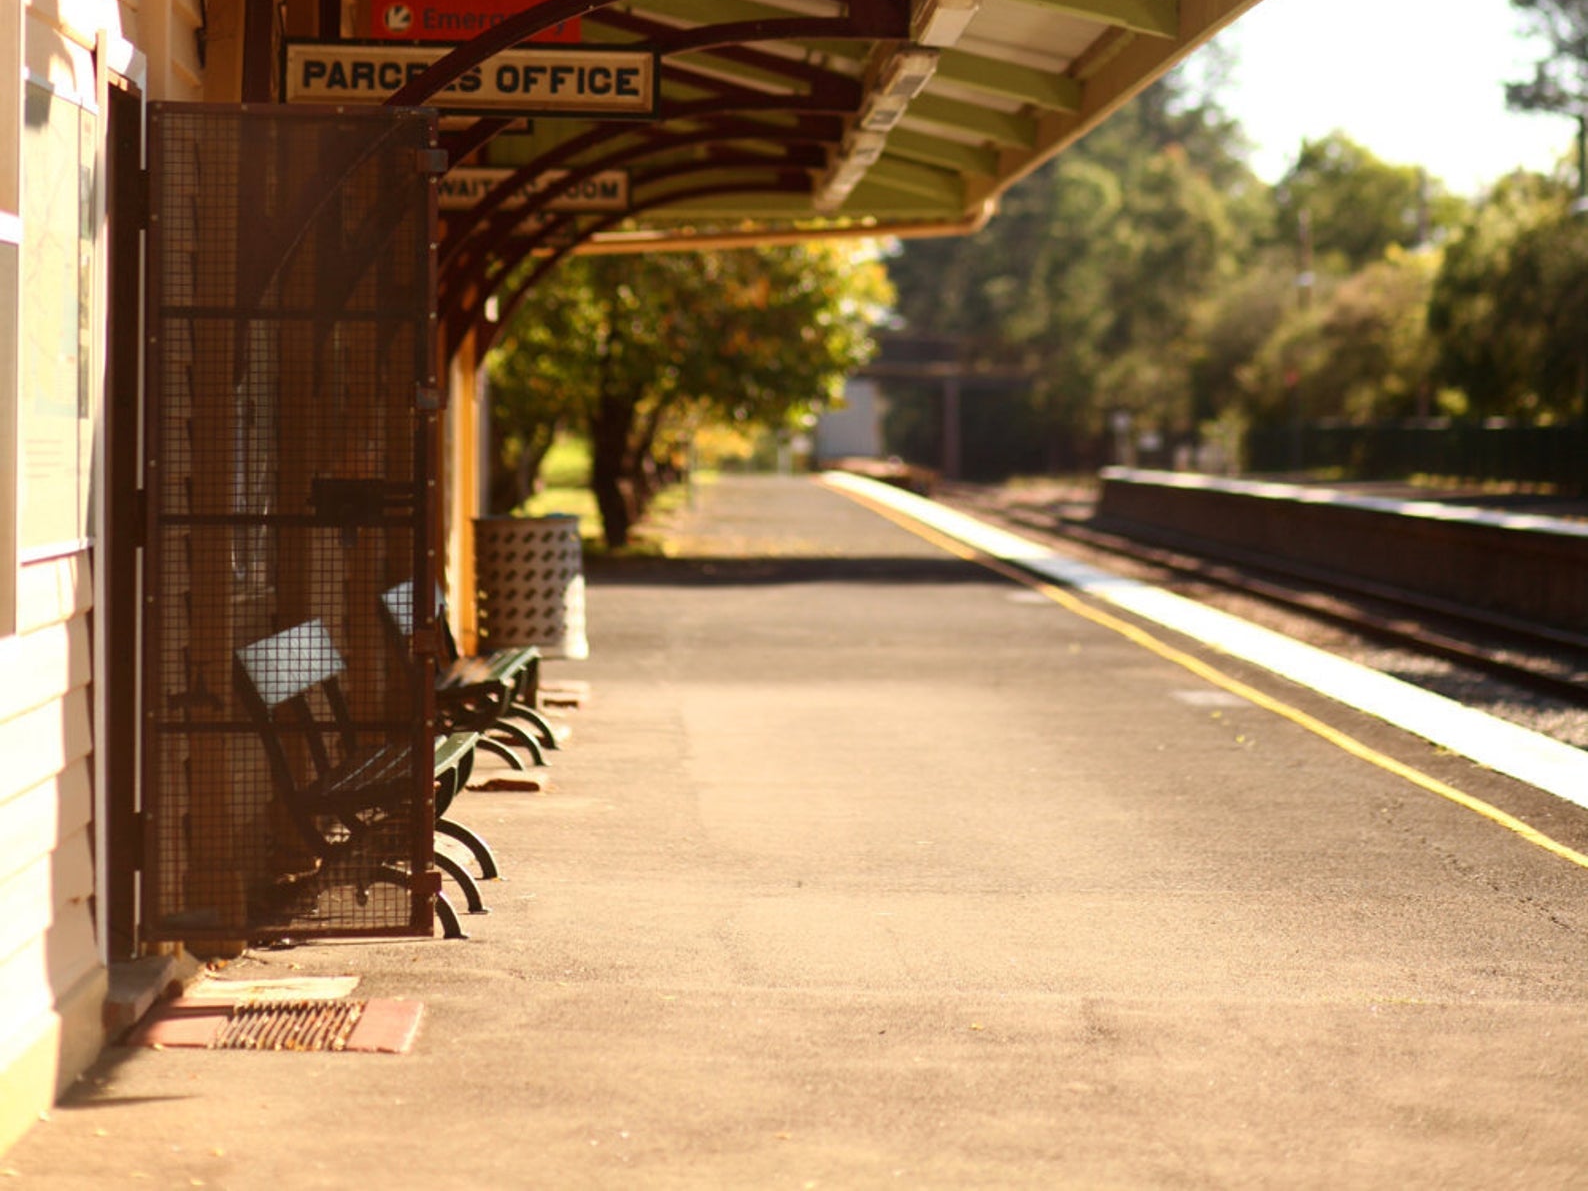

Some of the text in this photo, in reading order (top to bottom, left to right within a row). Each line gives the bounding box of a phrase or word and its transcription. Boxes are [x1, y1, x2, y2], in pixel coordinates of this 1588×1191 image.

[423, 7, 567, 36] Emery
[302, 60, 641, 97] PARCES OFFICE
[438, 179, 619, 200] WAITG OOM
